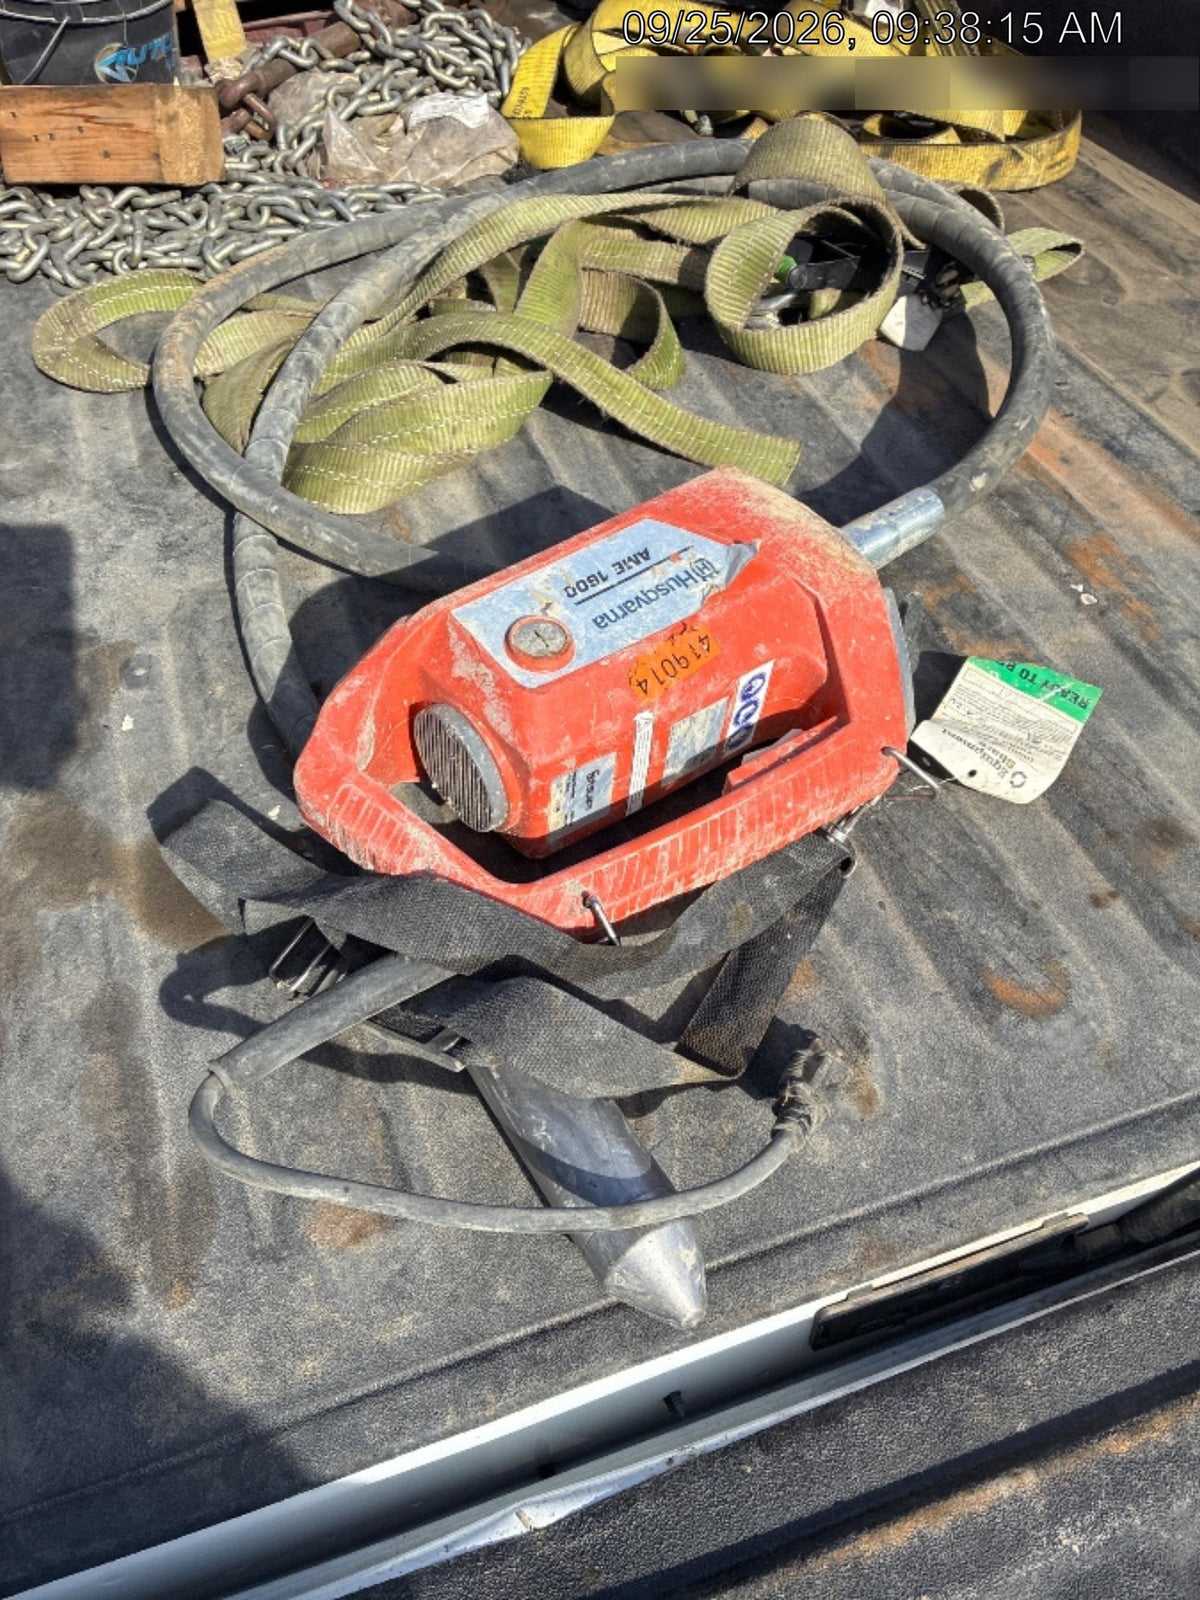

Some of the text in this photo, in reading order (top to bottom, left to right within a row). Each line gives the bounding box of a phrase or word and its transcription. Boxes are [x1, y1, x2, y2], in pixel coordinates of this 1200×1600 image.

[563, 548, 651, 598] AME 1600
[592, 568, 699, 629] Husqvarna
[636, 635, 711, 695] 419014
[1019, 665, 1037, 685] TO
[1041, 681, 1090, 710] READY
